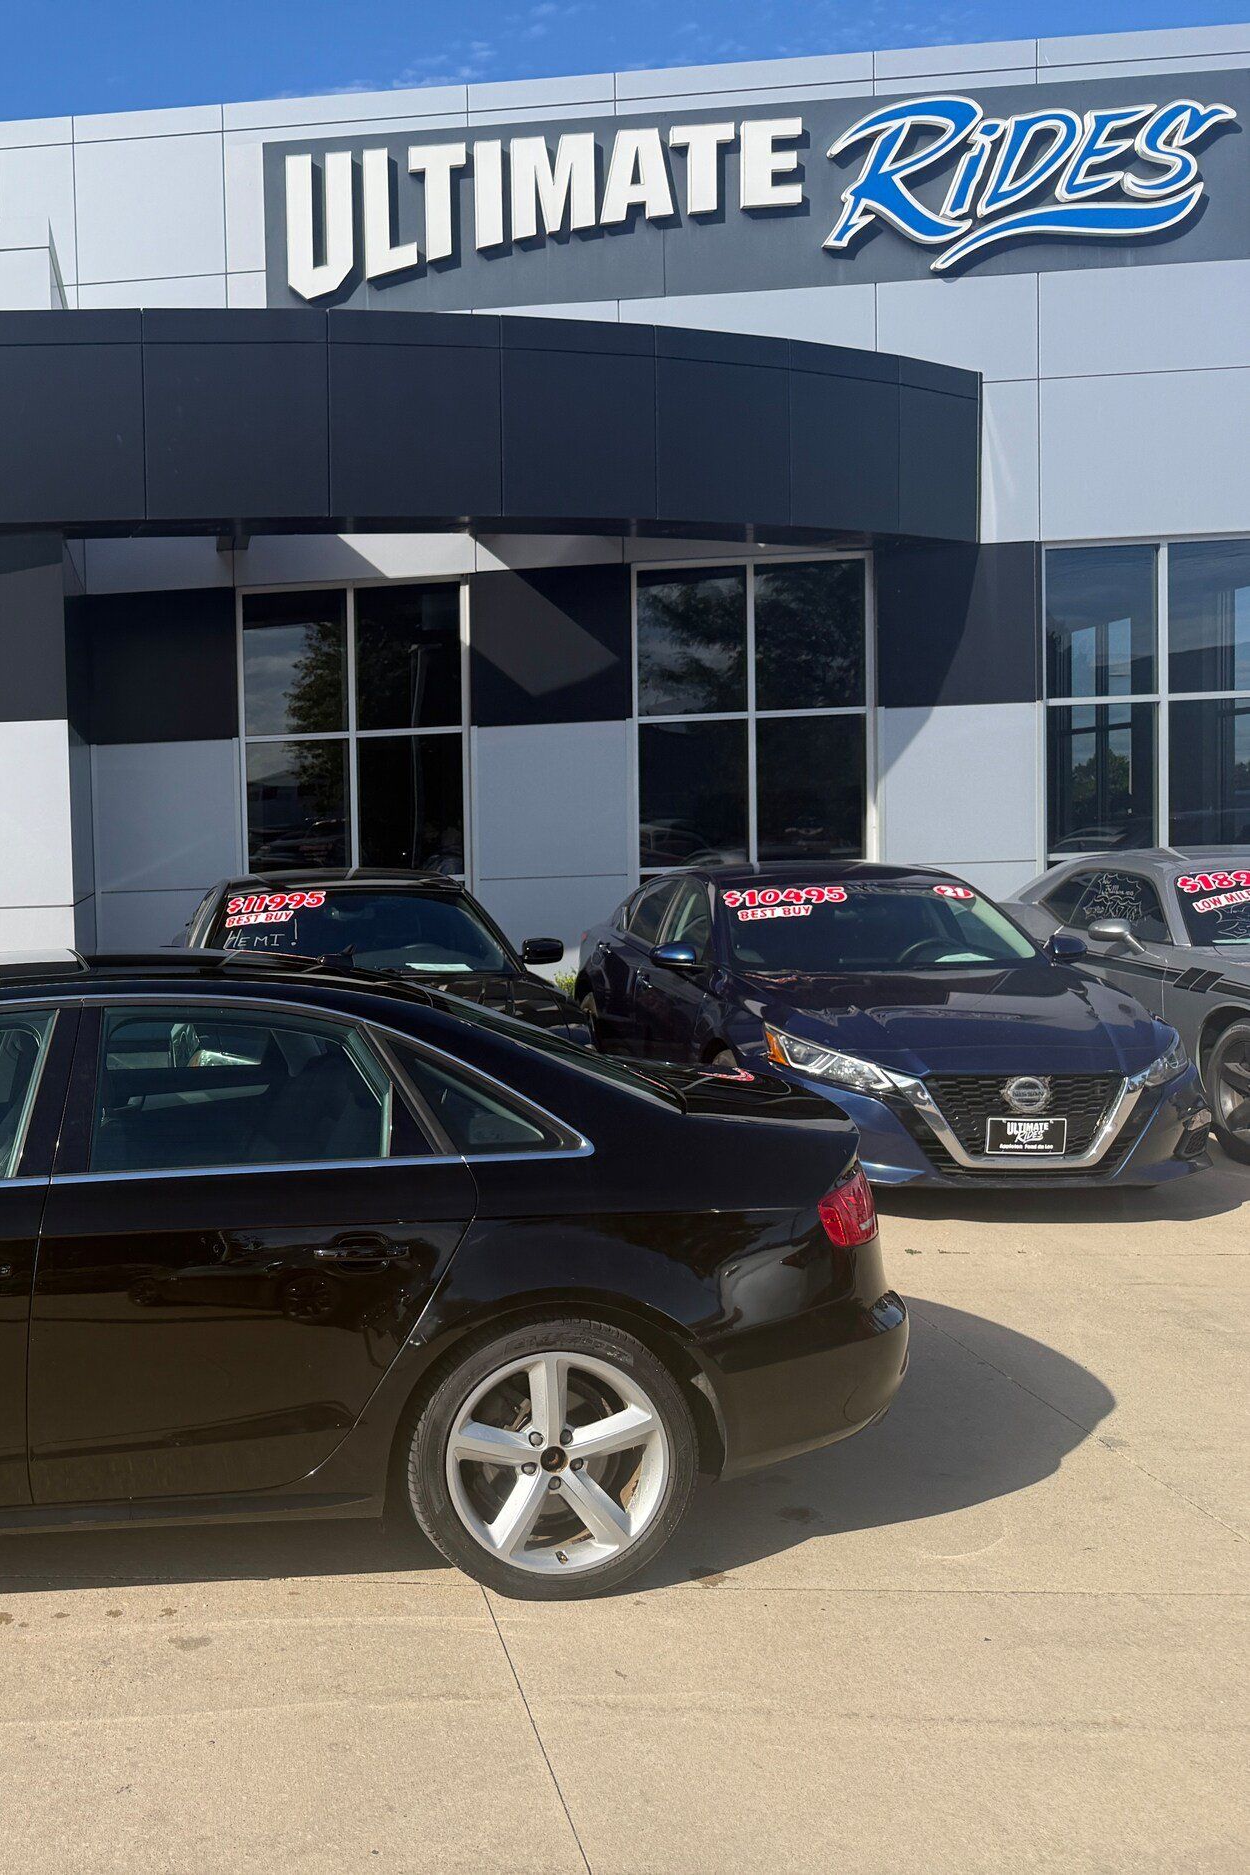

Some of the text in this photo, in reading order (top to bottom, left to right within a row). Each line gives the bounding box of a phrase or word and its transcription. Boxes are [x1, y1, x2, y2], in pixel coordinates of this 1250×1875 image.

[286, 117, 804, 302] ULTIMATE
[227, 891, 326, 914] $11995
[723, 887, 967, 907] $10495 21
[1193, 896, 1223, 912] LOW
[226, 911, 294, 927] BEST BUY
[738, 905, 812, 921] BEST BUY
[1007, 1122, 1048, 1135] ULTIMATE
